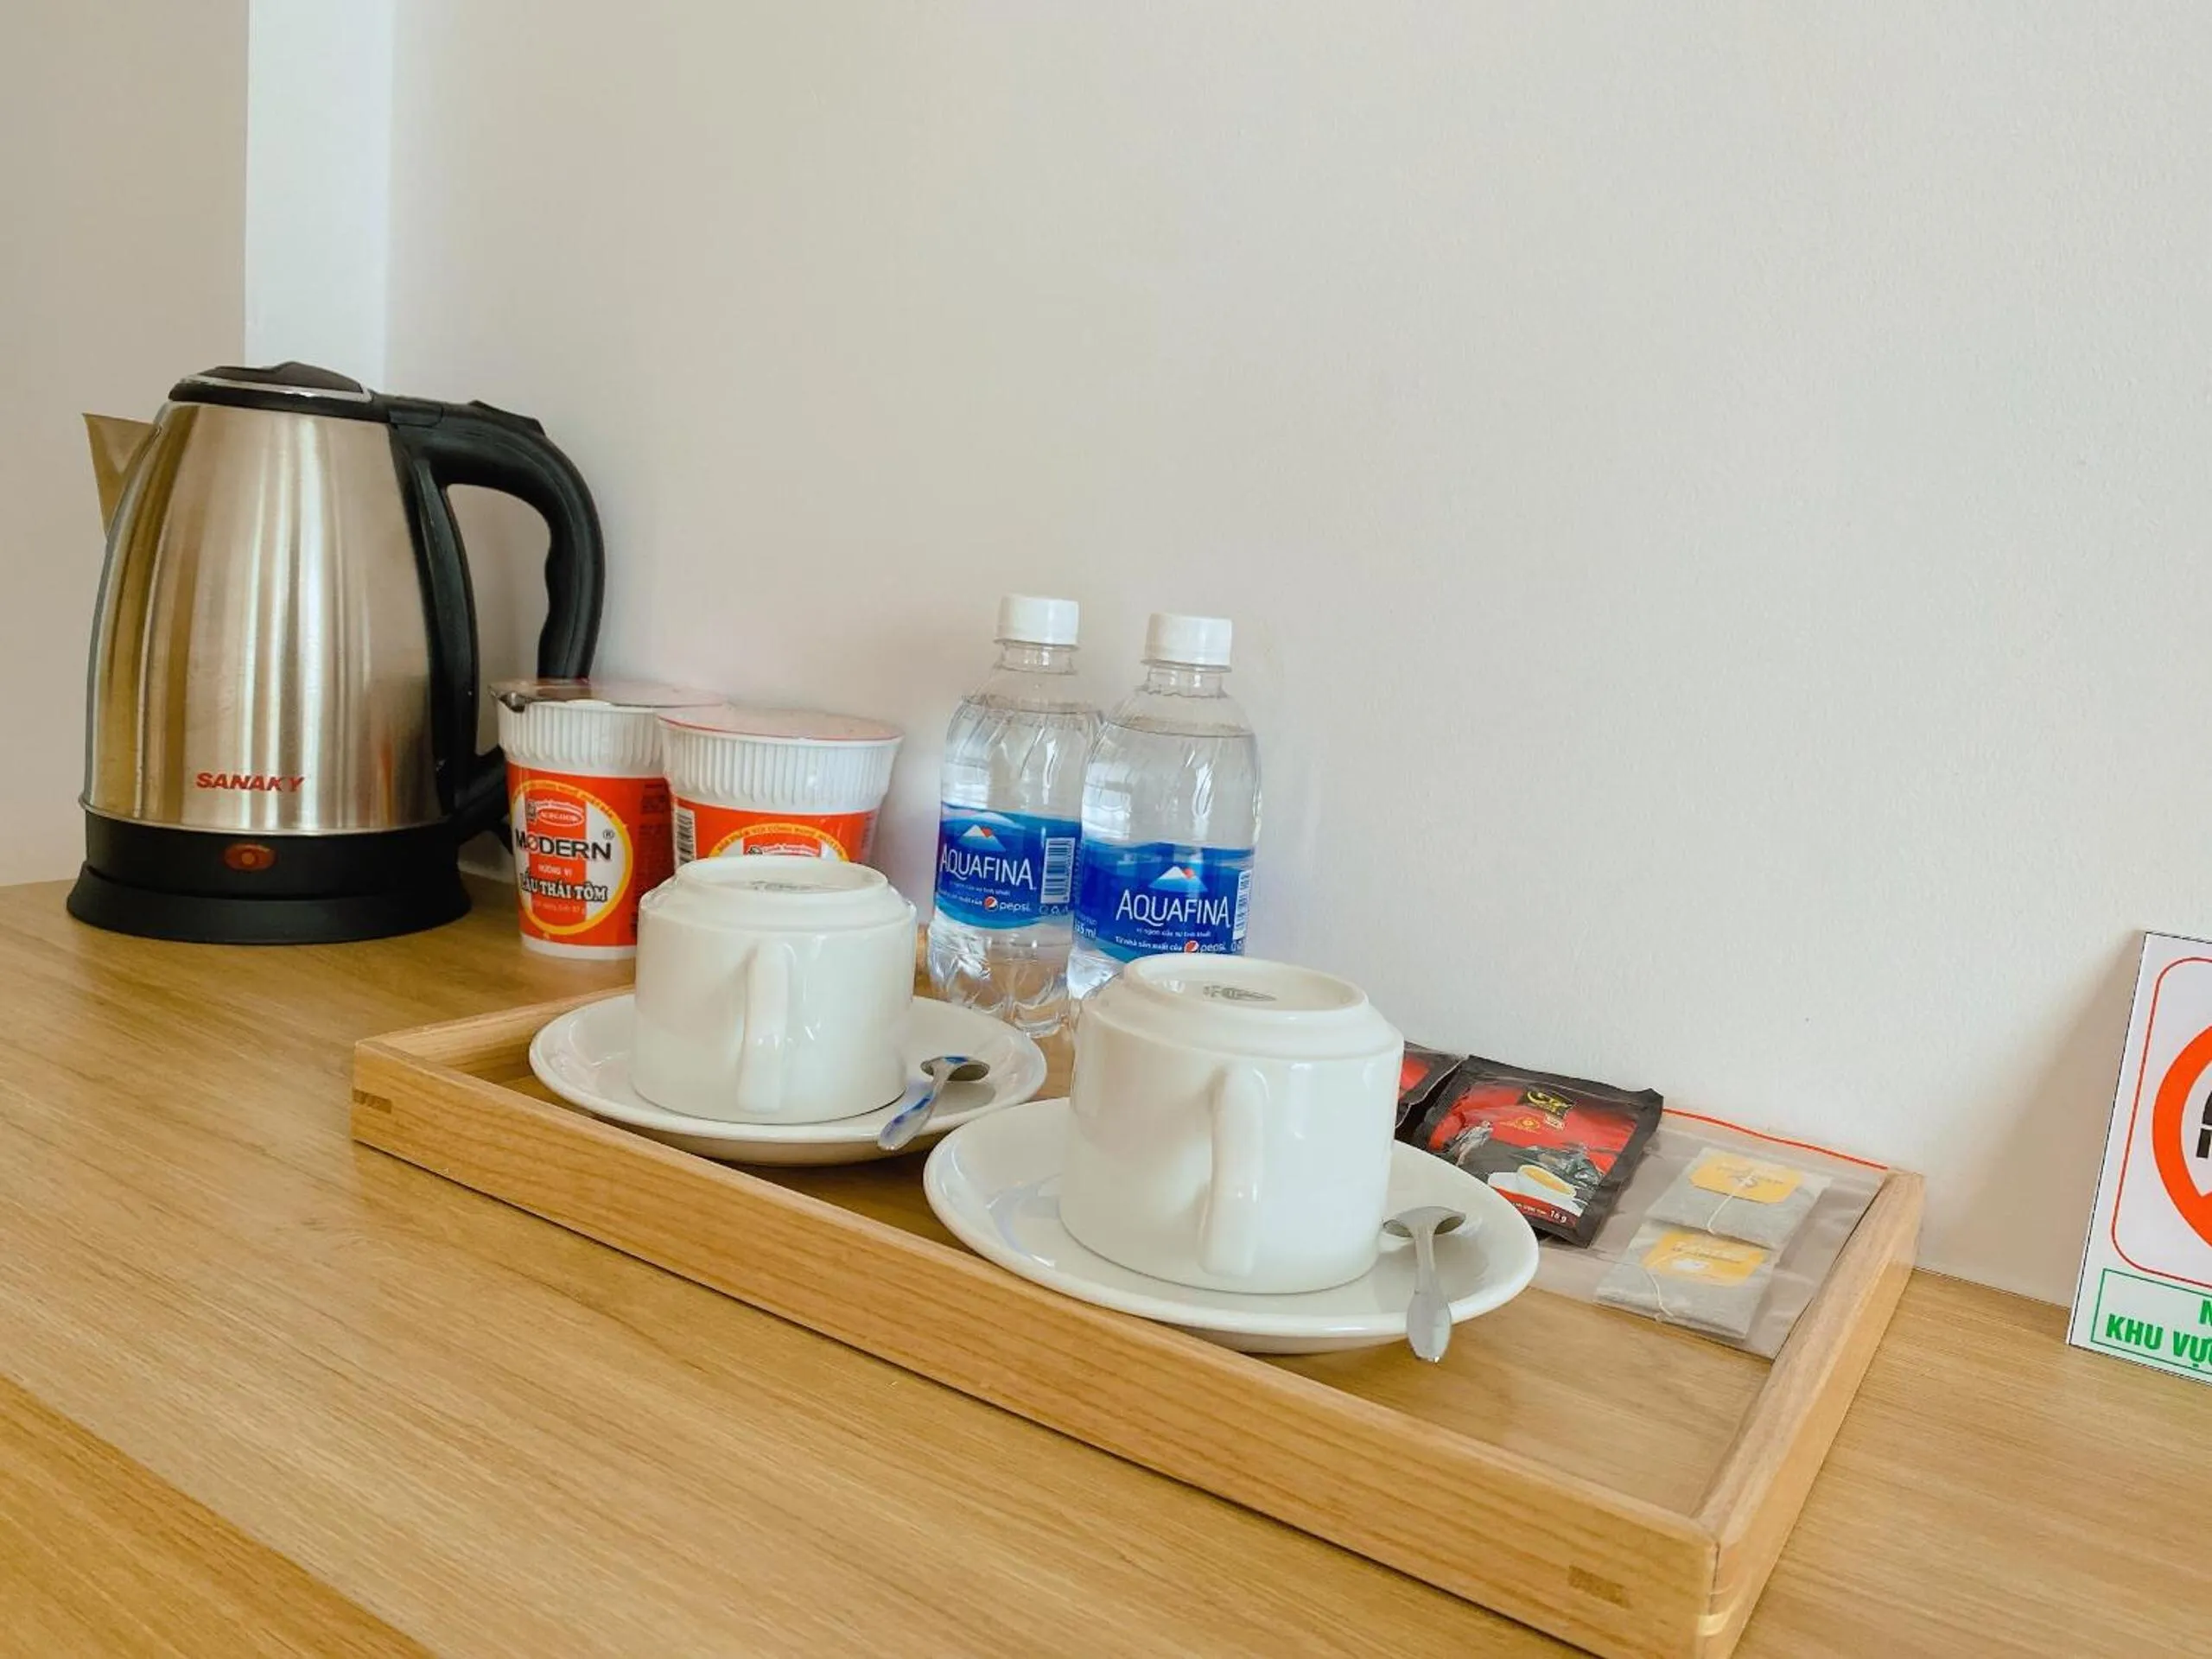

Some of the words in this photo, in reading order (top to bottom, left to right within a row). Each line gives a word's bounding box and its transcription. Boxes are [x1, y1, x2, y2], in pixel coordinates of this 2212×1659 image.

[196, 772, 304, 792] SANAKY
[515, 829, 612, 861] MODERN
[939, 842, 1033, 891] AQUAFINA
[1116, 888, 1231, 929] AQUAFINA
[2105, 1313, 2164, 1351] KHU
[2172, 1331, 2212, 1368] VỰ
